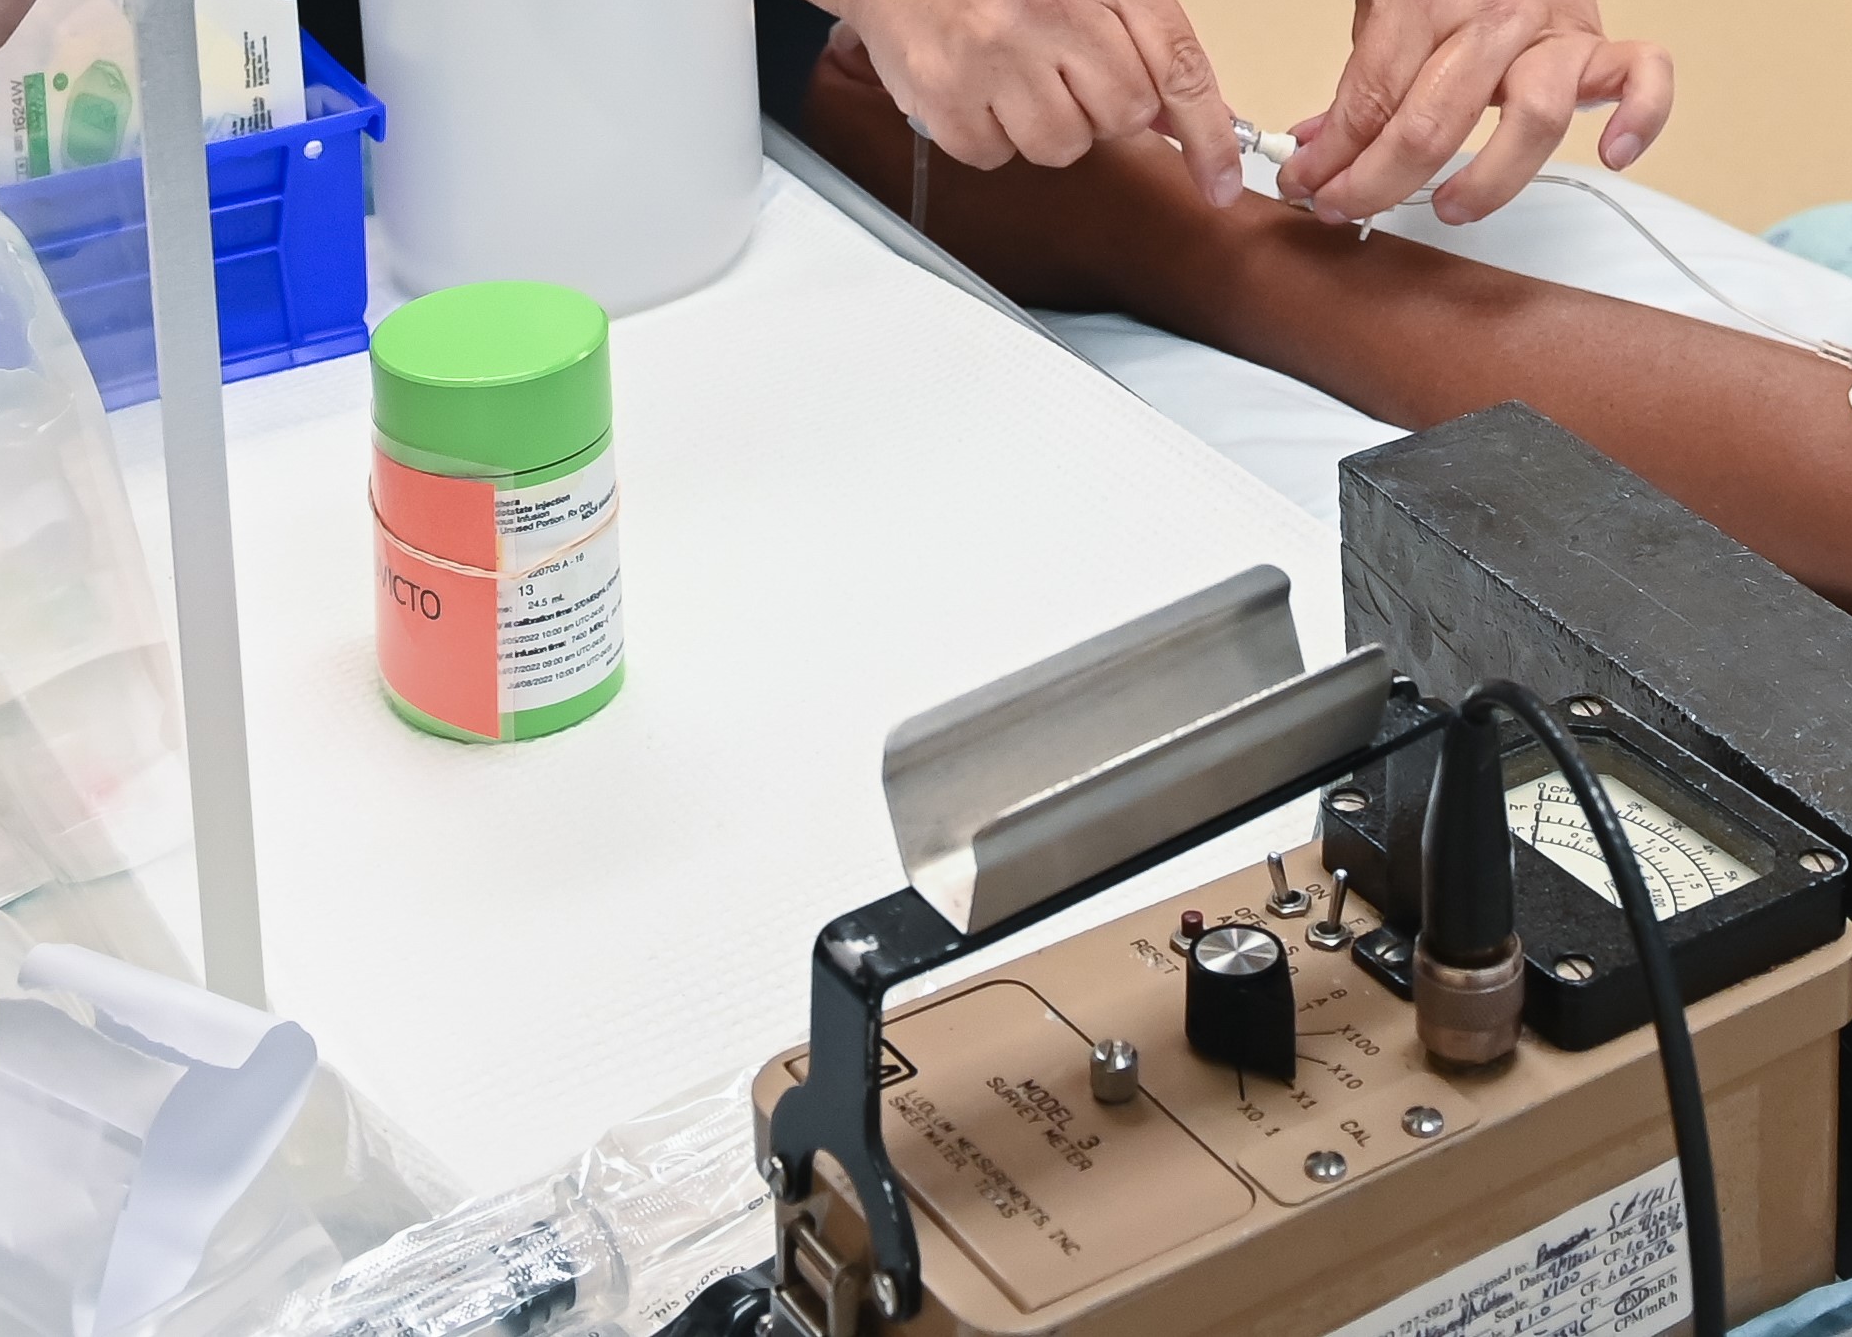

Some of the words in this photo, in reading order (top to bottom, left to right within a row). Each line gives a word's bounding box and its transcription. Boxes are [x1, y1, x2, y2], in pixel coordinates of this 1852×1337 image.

[10, 80, 26, 132] 1624W
[535, 494, 570, 510] Injection
[377, 557, 441, 621] VICTO
[518, 584, 534, 596] 13
[528, 598, 548, 610] 24.5
[1627, 801, 1647, 812] 2K
[1684, 873, 1703, 889] 1.5
[1724, 870, 1739, 882] 5K
[1305, 883, 1331, 900] ON
[1234, 907, 1267, 927] OFF
[1129, 937, 1180, 975] RESET
[1337, 1023, 1380, 1057] X100
[1326, 1063, 1364, 1091] X10
[904, 1088, 957, 1134] LUDLUM
[1290, 1090, 1317, 1111] X1
[985, 1076, 1047, 1125] SURVEY
[1042, 1128, 1094, 1173] METER
[1016, 1078, 1074, 1133] MODEL
[1075, 1134, 1103, 1152] 3
[1236, 1101, 1281, 1137] X0.1
[1339, 1119, 1375, 1148] CAL
[974, 1177, 1019, 1220] TEXAS
[1610, 1225, 1635, 1245] Due:
[1494, 1300, 1527, 1323] Scale:
[1542, 1271, 1580, 1299] X100
[1603, 1248, 1623, 1266] CF:
[1580, 1279, 1601, 1298] CF:
[1399, 1298, 1454, 1335] 727-5922
[1458, 1268, 1512, 1307] Assigned
[1580, 1296, 1601, 1315] CF:
[1614, 1290, 1679, 1333] CPM/mR/h
